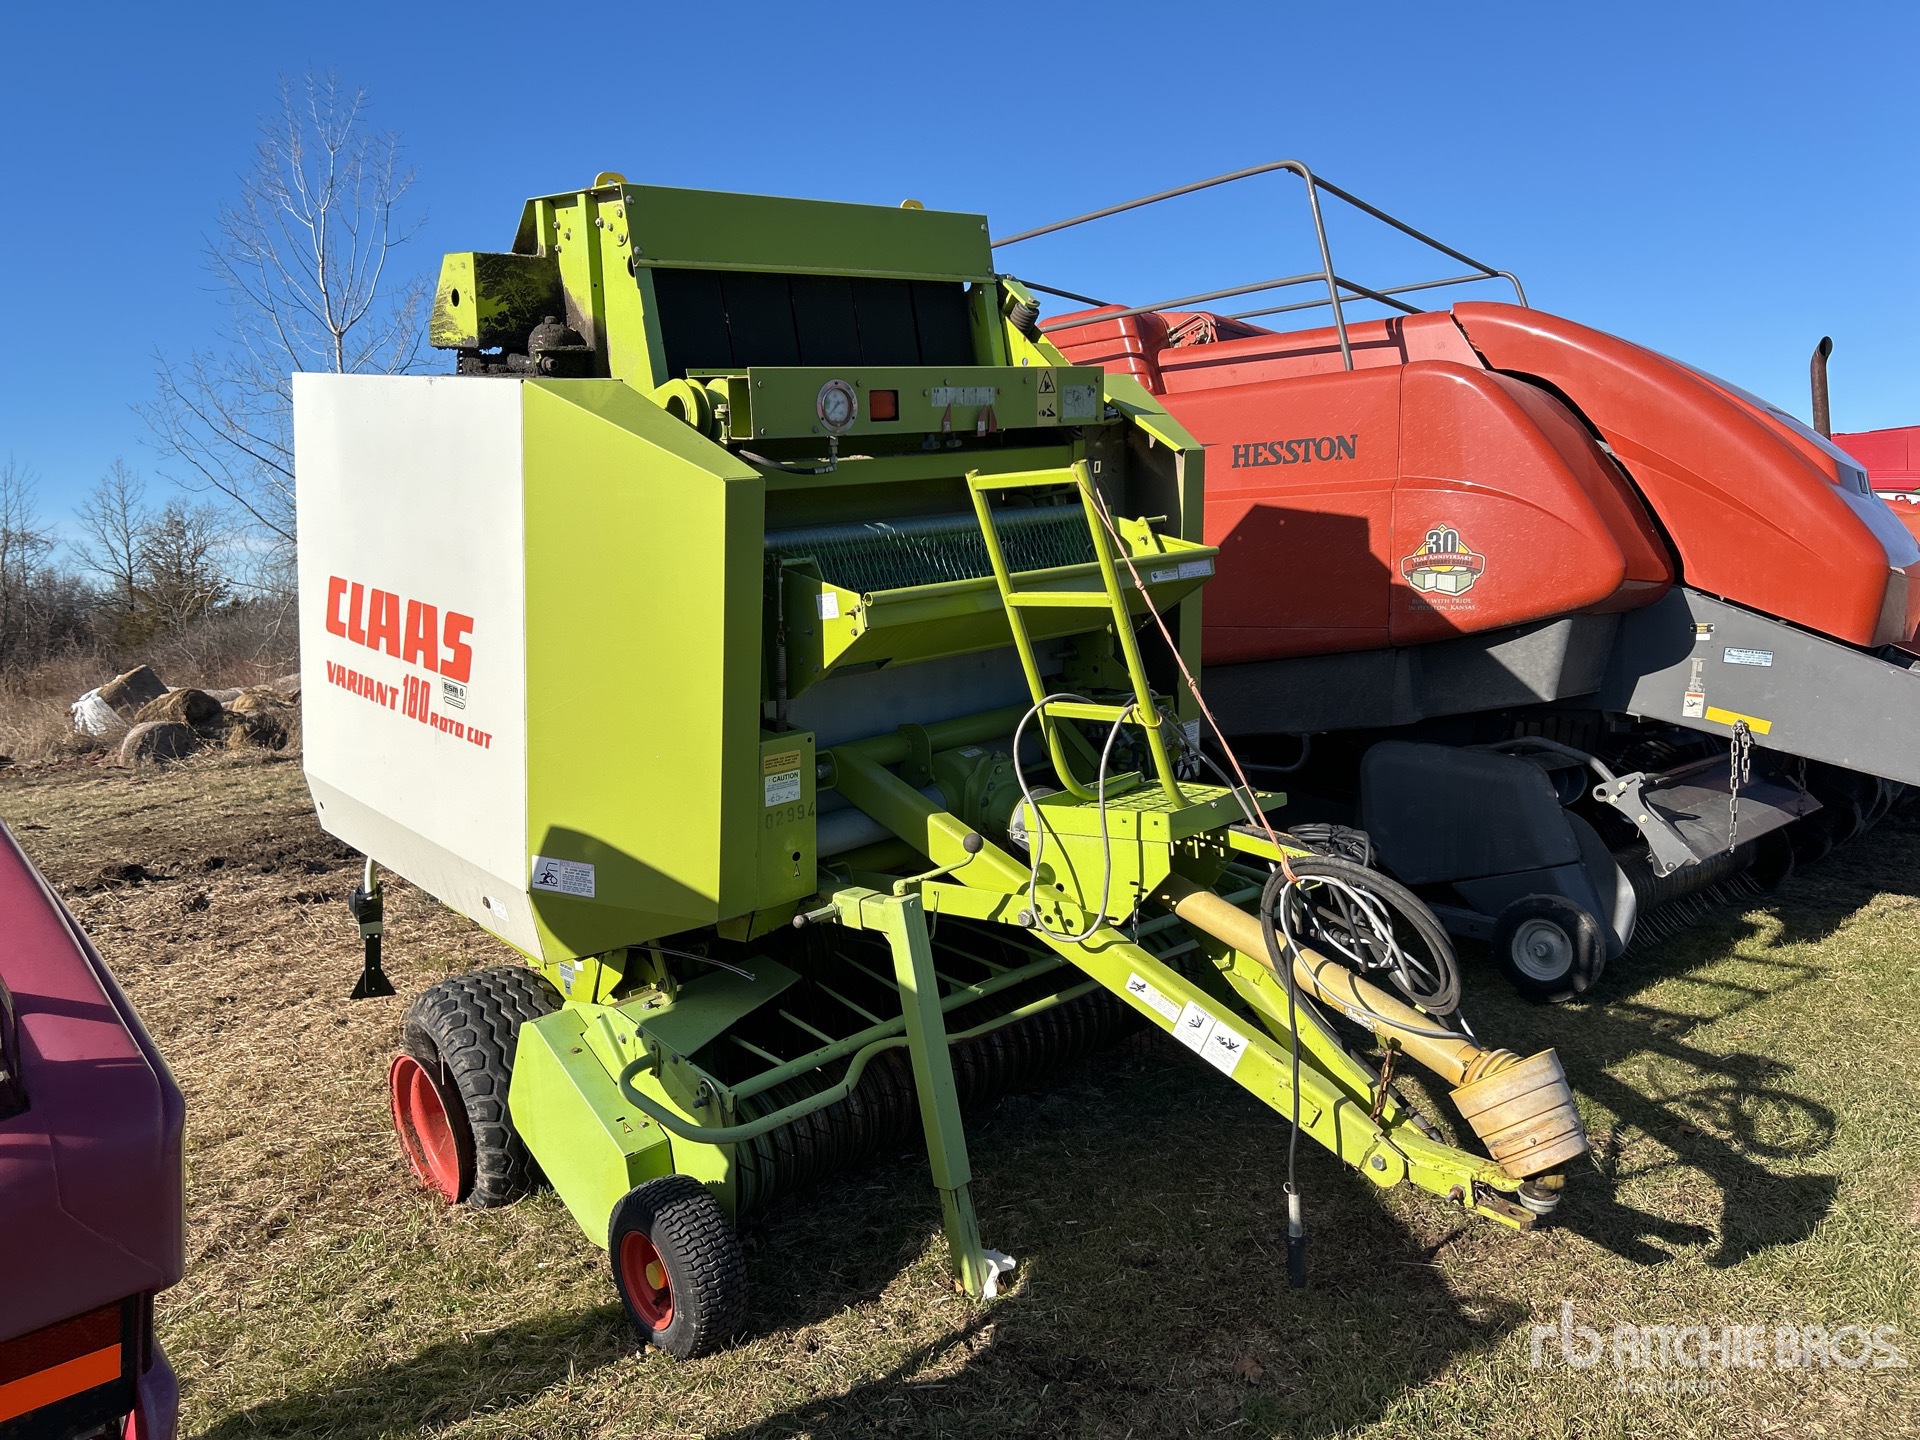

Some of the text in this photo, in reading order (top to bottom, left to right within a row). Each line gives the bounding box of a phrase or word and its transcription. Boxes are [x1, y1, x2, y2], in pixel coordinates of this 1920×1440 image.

[1232, 434, 1358, 468] HESSTON
[1427, 531, 1457, 554] 30
[326, 575, 474, 683] CLAAS
[327, 660, 492, 749] VARIANT 180 ROTO CUT
[773, 772, 799, 783] CAUTION
[765, 802, 815, 830] 02994
